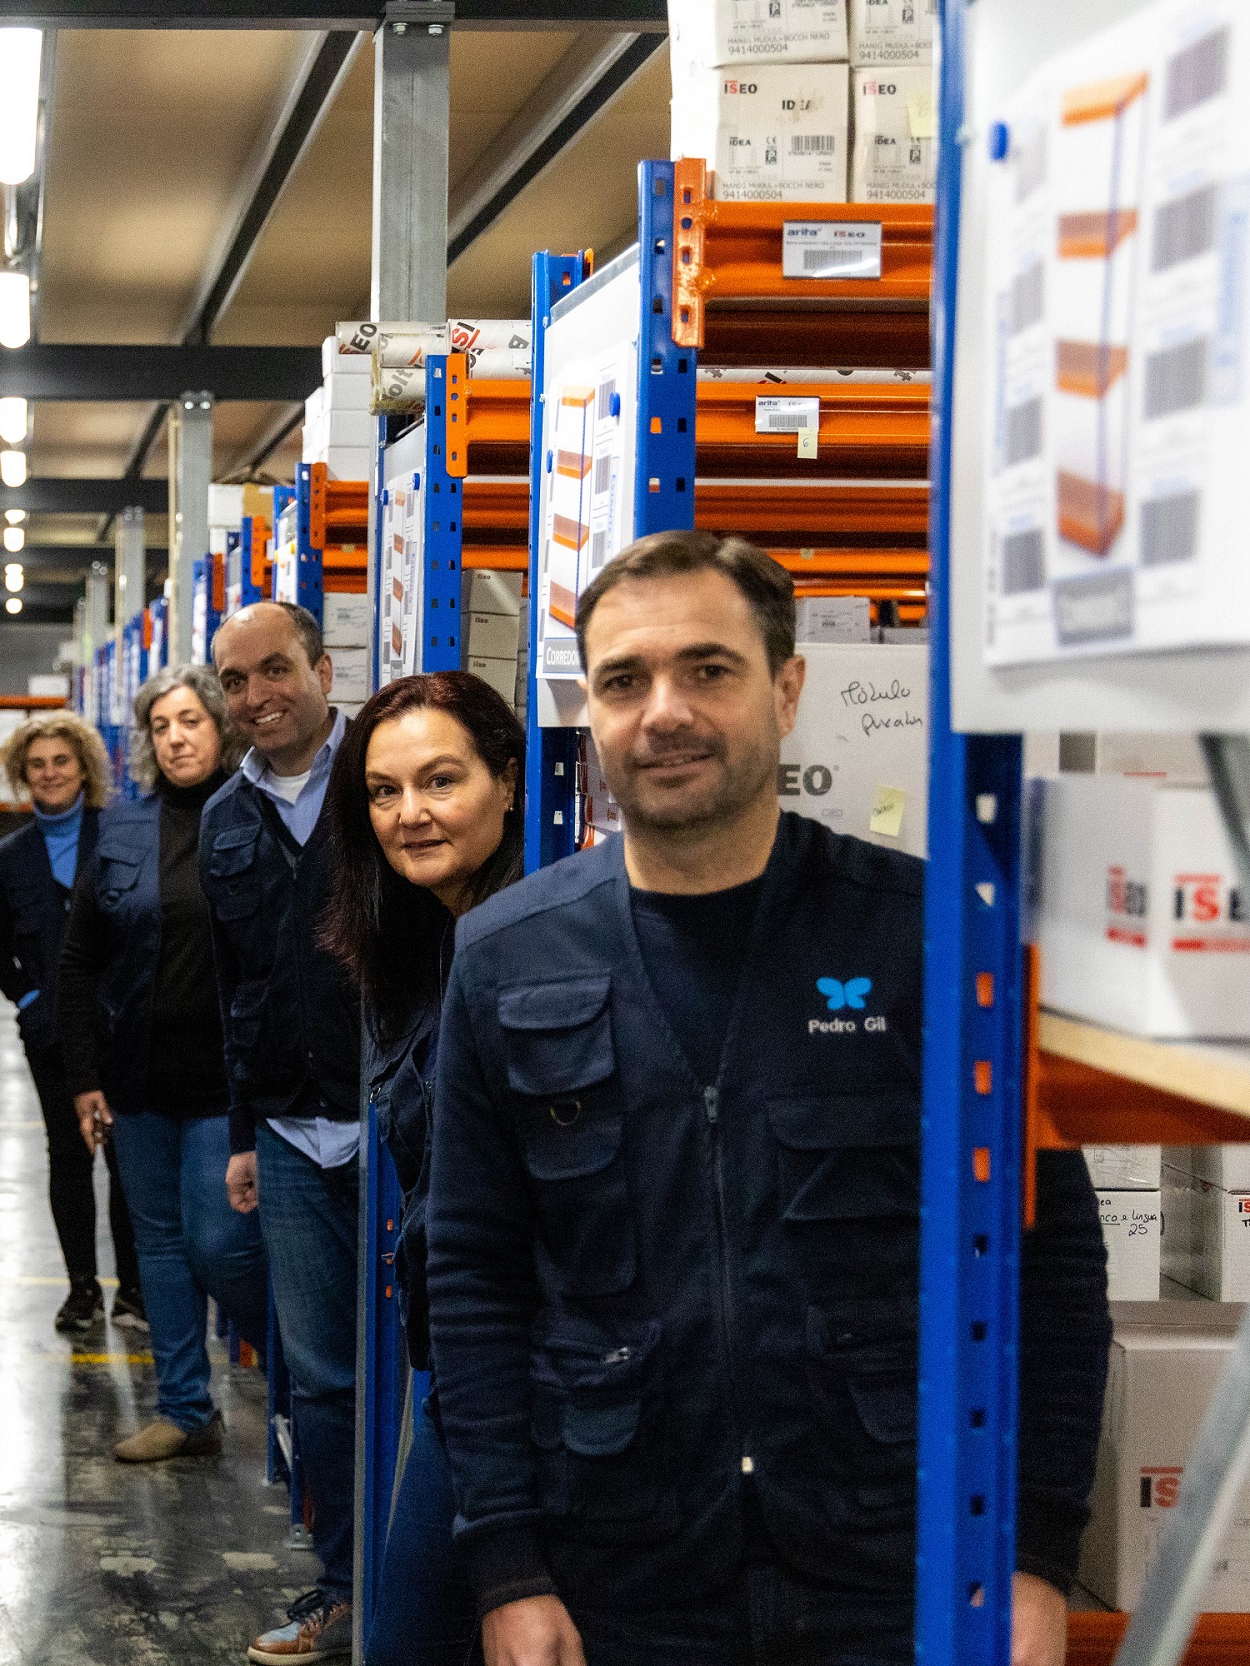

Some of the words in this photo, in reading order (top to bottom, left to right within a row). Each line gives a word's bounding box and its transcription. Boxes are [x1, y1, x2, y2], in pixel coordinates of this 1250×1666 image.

[728, 43, 788, 54] 9414000504
[859, 50, 919, 60] 9414000504
[724, 81, 758, 94] ISEO
[863, 82, 897, 95] ISEO
[802, 437, 810, 448] 6
[808, 1018, 856, 1034] Pedro
[864, 1016, 886, 1032] Gil
[1128, 1223, 1149, 1237] 25
